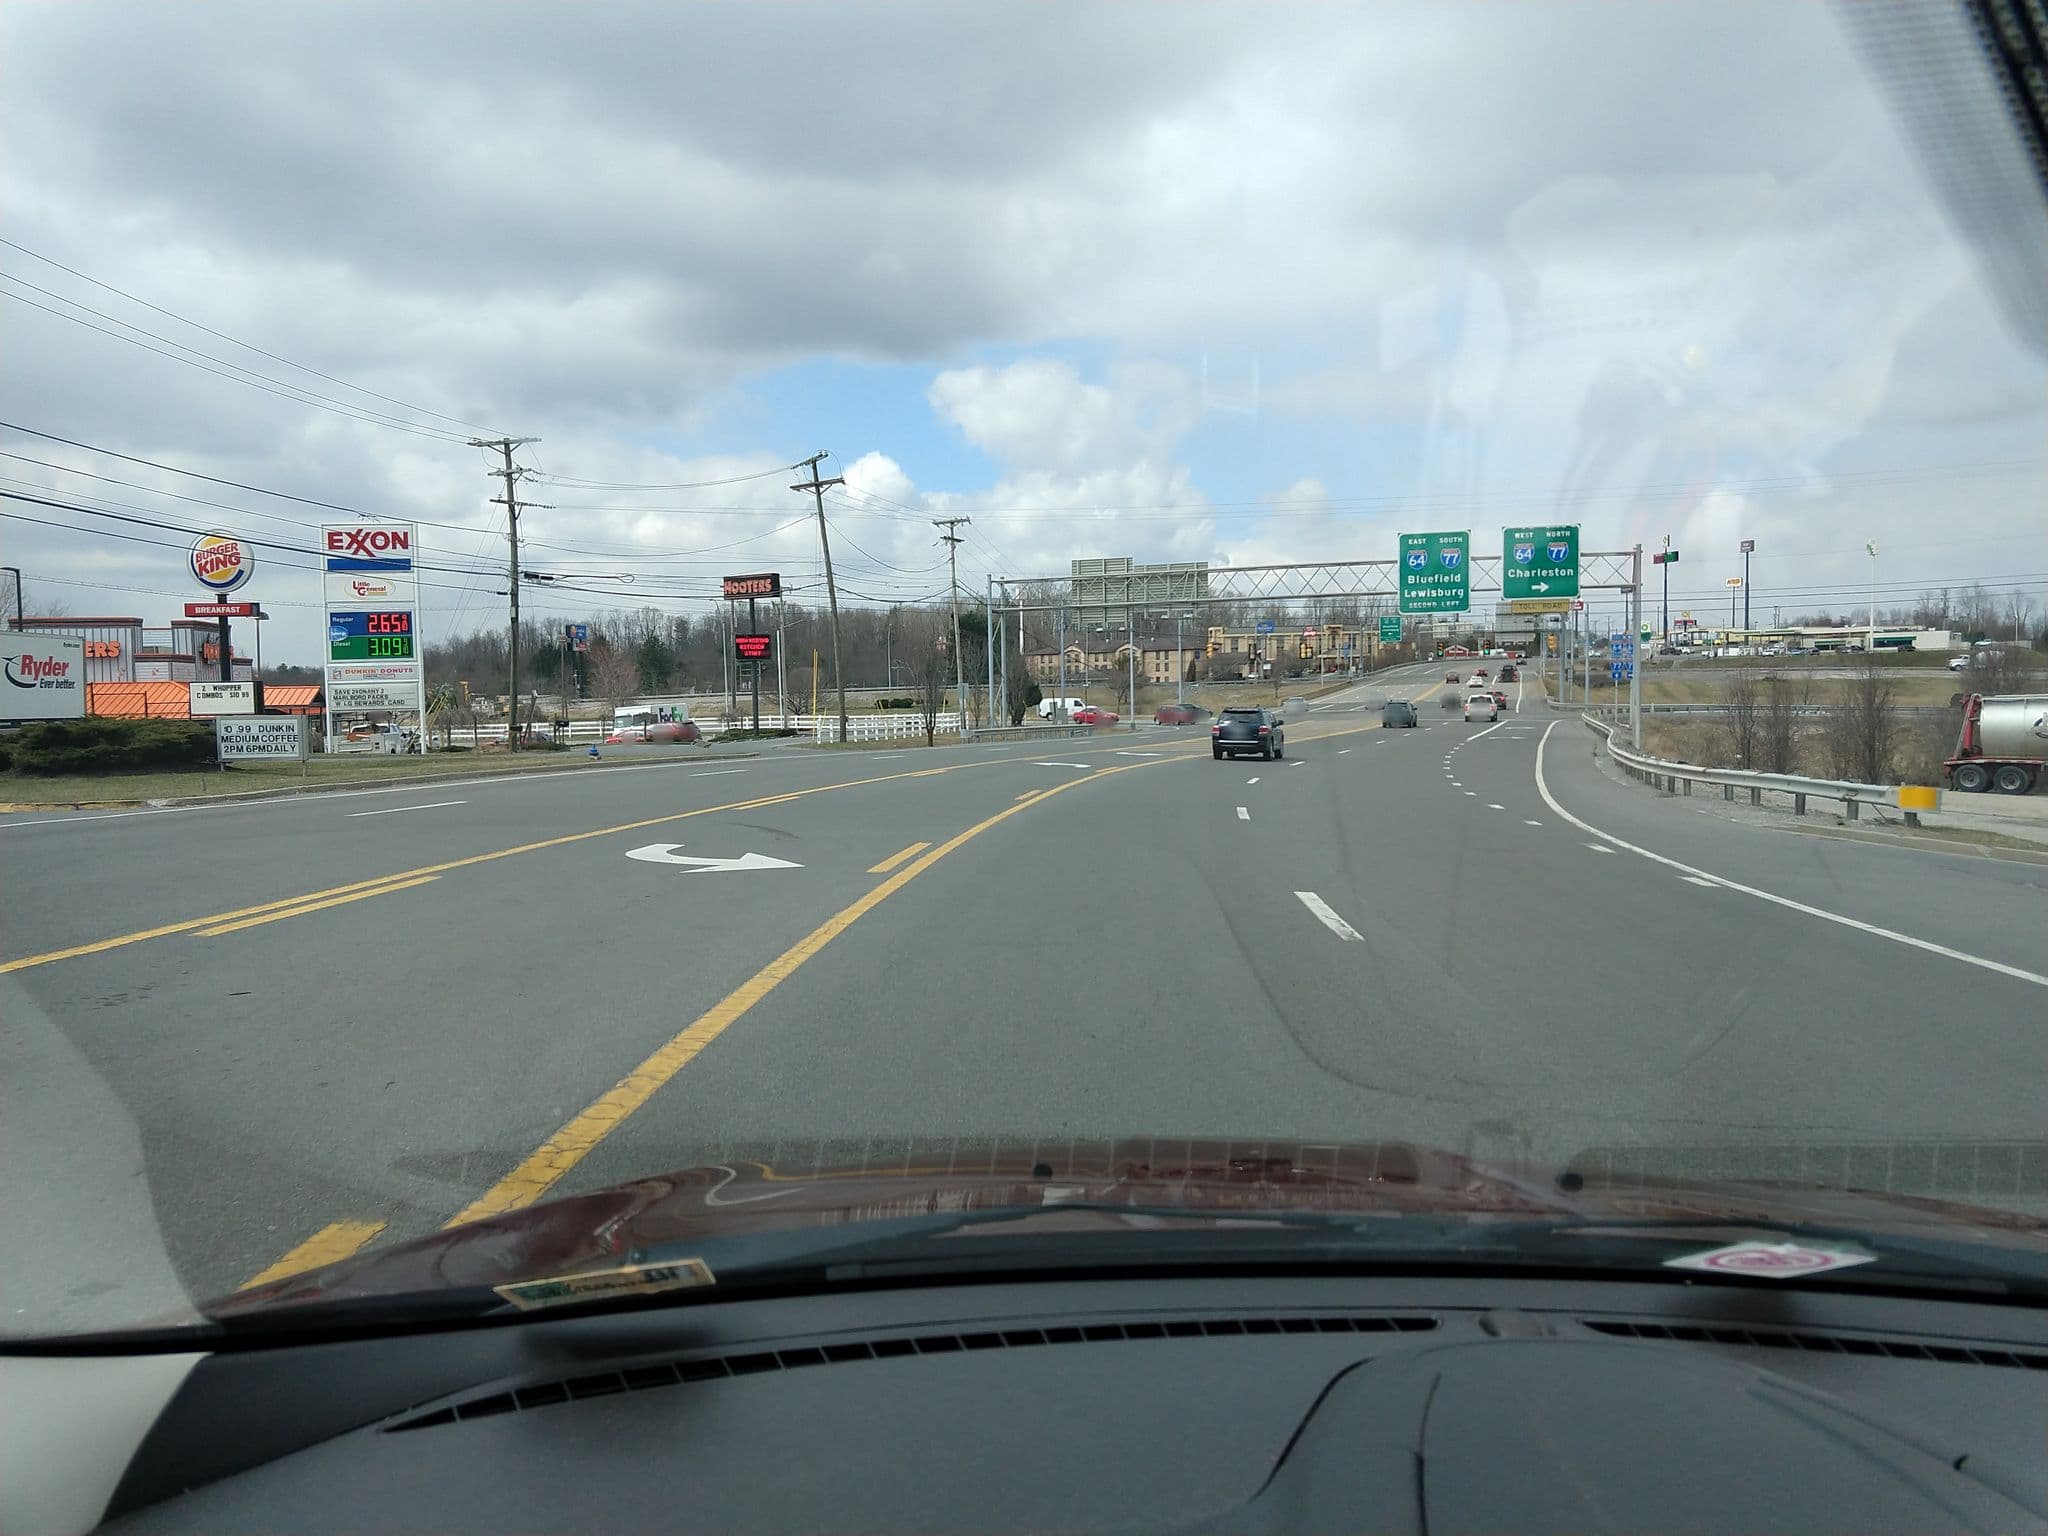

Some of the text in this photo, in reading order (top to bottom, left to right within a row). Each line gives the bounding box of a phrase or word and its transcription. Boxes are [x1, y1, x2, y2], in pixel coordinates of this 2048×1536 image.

[327, 528, 409, 557] EXXON
[195, 542, 239, 563] BURGER
[1516, 547, 1566, 560] 64 77
[198, 552, 241, 577] KING
[1409, 553, 1459, 567] 64 77
[1508, 567, 1574, 578] Charleston
[1408, 573, 1461, 584] Bluefield
[724, 578, 772, 594] HOOTERS
[1404, 588, 1464, 599] Lewisburg
[195, 606, 241, 614] BREAKFAST
[20, 654, 69, 681] Ryder
[40, 678, 54, 689] Ever
[258, 724, 295, 733] DUNKIN
[221, 734, 299, 744] MEDIUM COFFEE
[223, 745, 244, 754] 2PM
